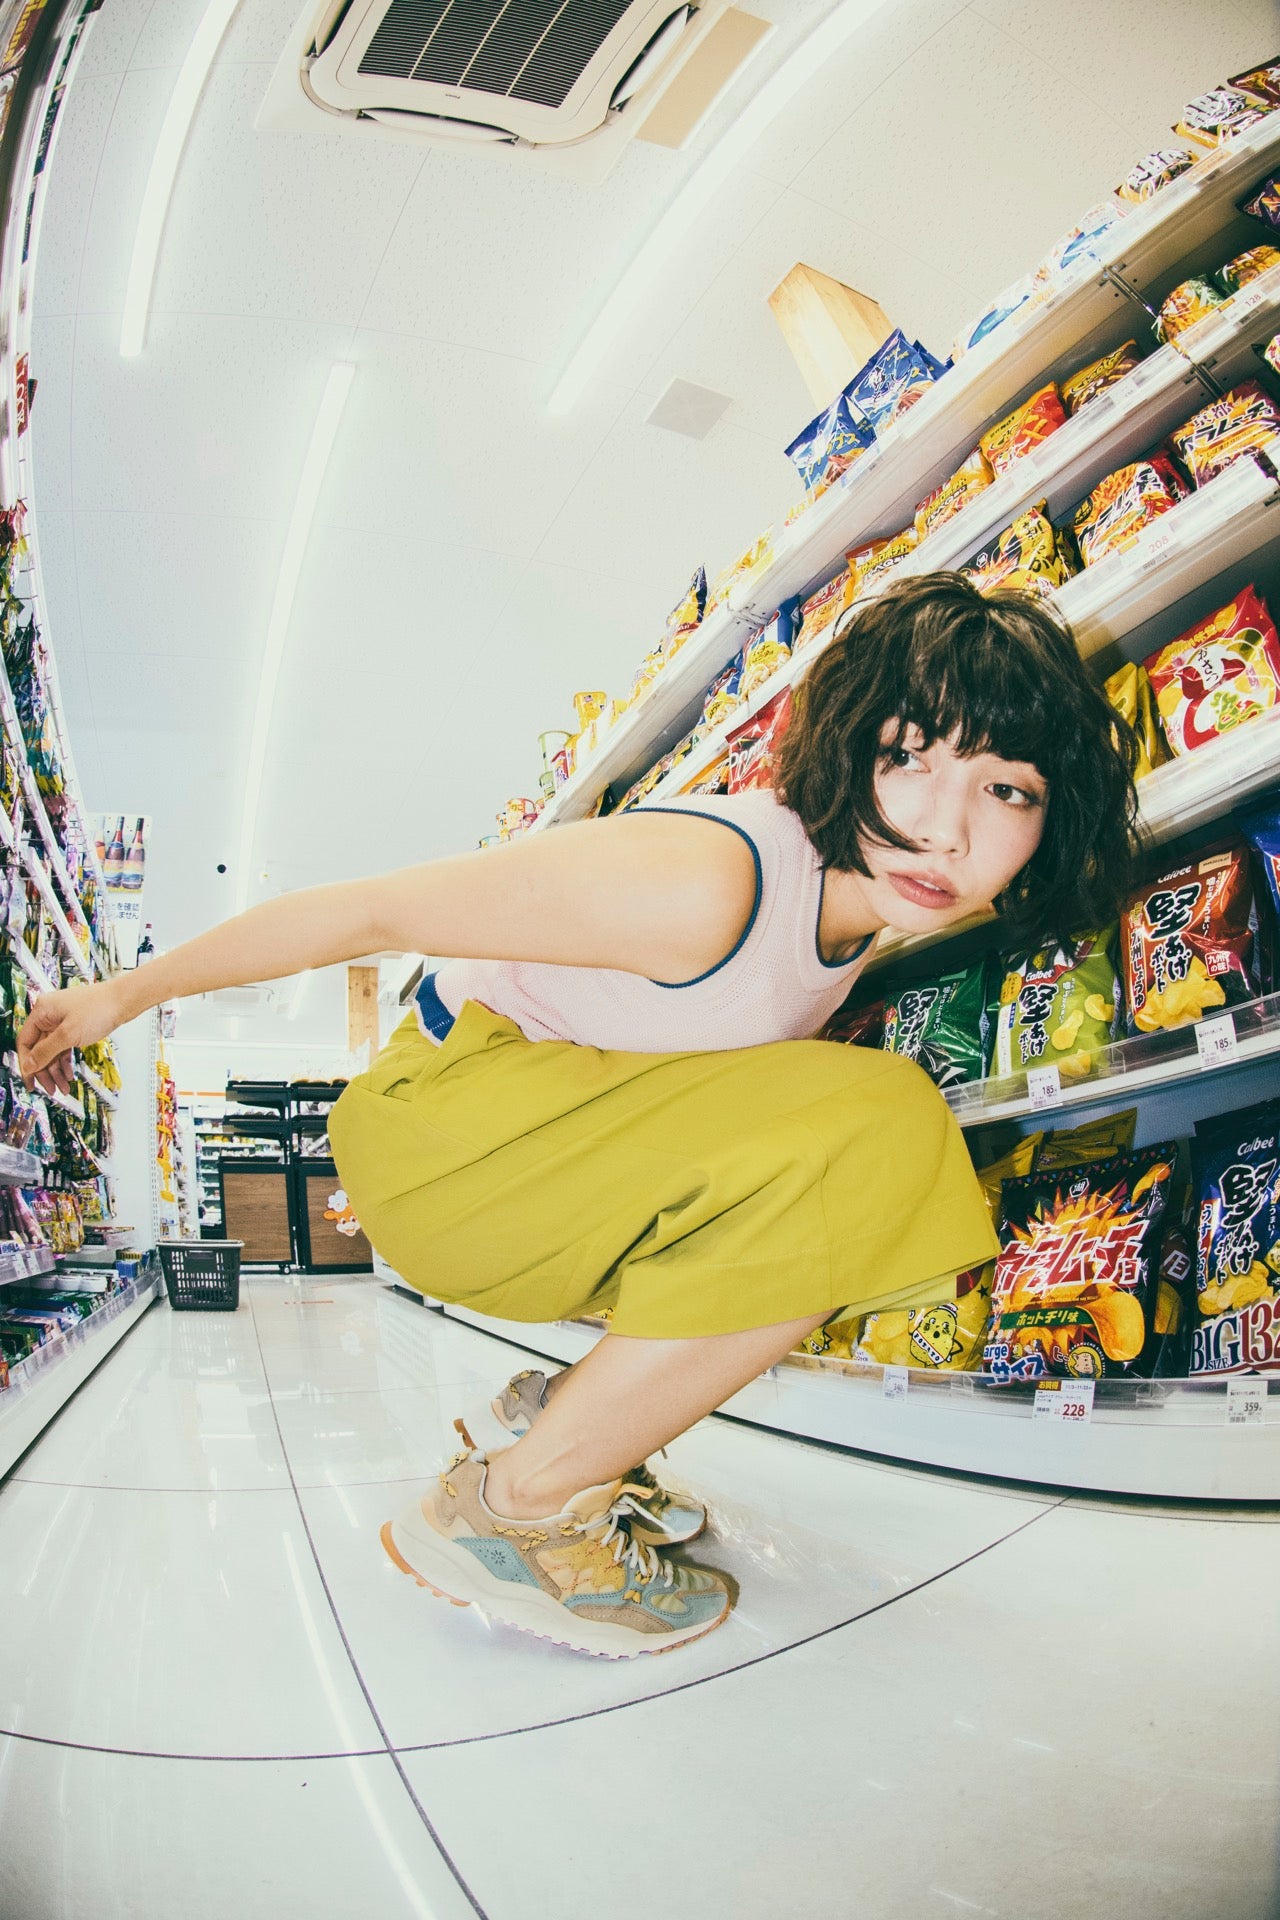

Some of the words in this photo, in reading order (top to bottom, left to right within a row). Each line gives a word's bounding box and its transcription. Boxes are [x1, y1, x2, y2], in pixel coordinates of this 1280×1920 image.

[1214, 1037, 1229, 1050] 185
[1042, 1085, 1055, 1096] 185
[1237, 1136, 1275, 1156] Calbee
[1016, 1310, 1080, 1326] ホットチリ味
[1190, 1315, 1241, 1373] BIG
[1239, 1299, 1280, 1364] 13
[1208, 1357, 1229, 1371] SIZE
[1062, 1403, 1086, 1417] 228
[1243, 1401, 1260, 1412] 359
